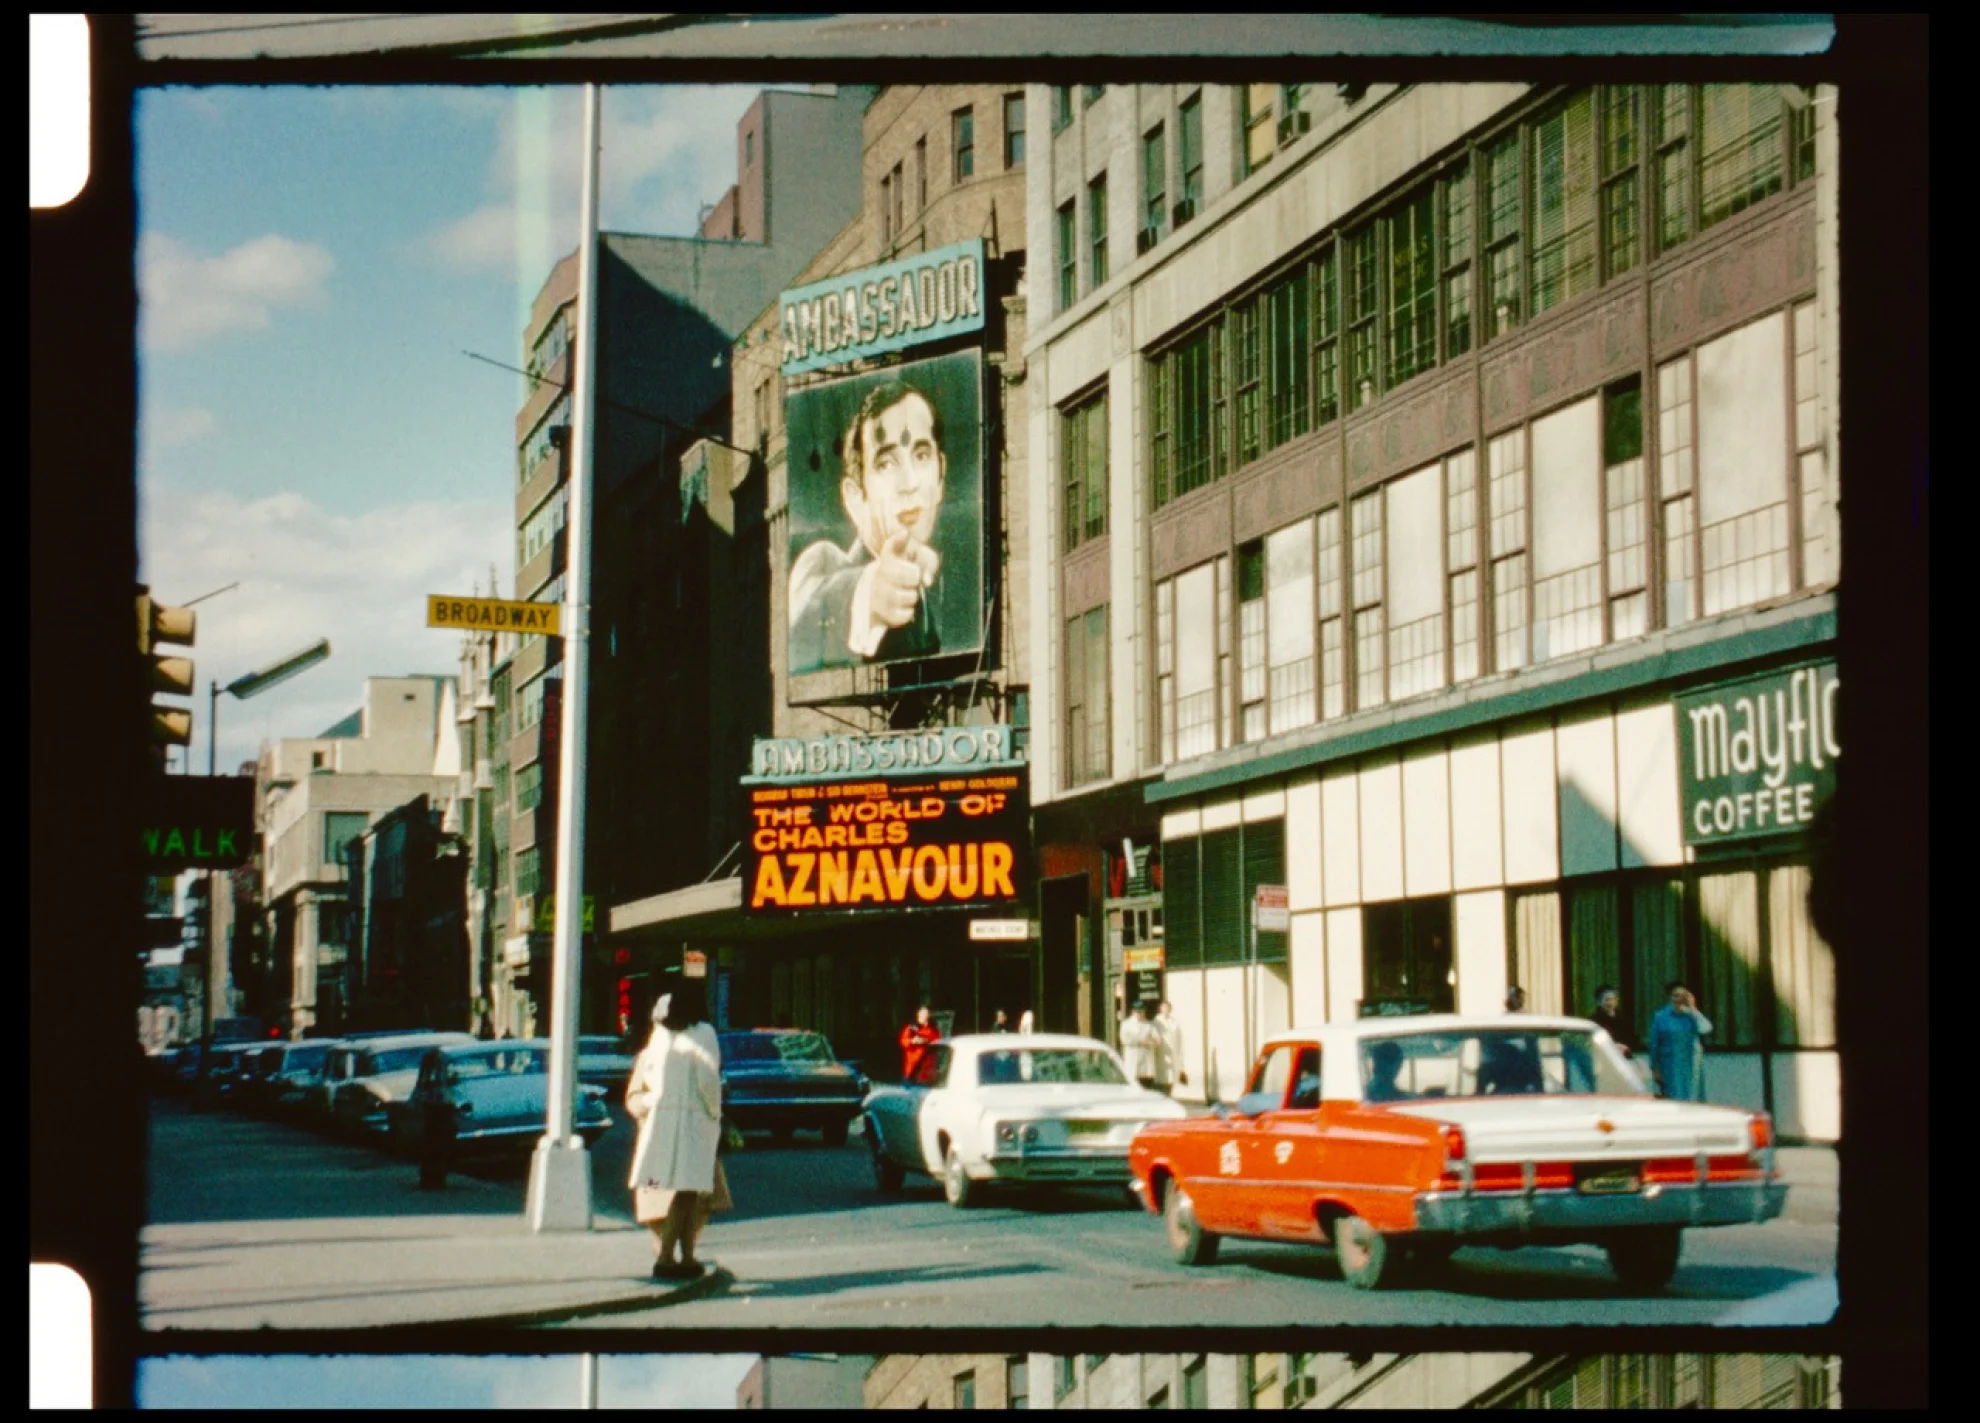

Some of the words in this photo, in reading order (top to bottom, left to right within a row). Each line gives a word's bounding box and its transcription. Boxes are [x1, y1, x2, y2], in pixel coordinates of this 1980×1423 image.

[782, 254, 979, 364] AMBASSADOR
[435, 602, 551, 628] BROADWAY
[759, 728, 1002, 775] AMBASSADOR
[752, 806, 812, 827] THE
[829, 797, 945, 822] WORLD
[960, 794, 1007, 815] OF
[1694, 783, 1815, 834] COFFEE
[753, 821, 909, 850] CHARLES
[751, 842, 1015, 908] AZNAVOUR
